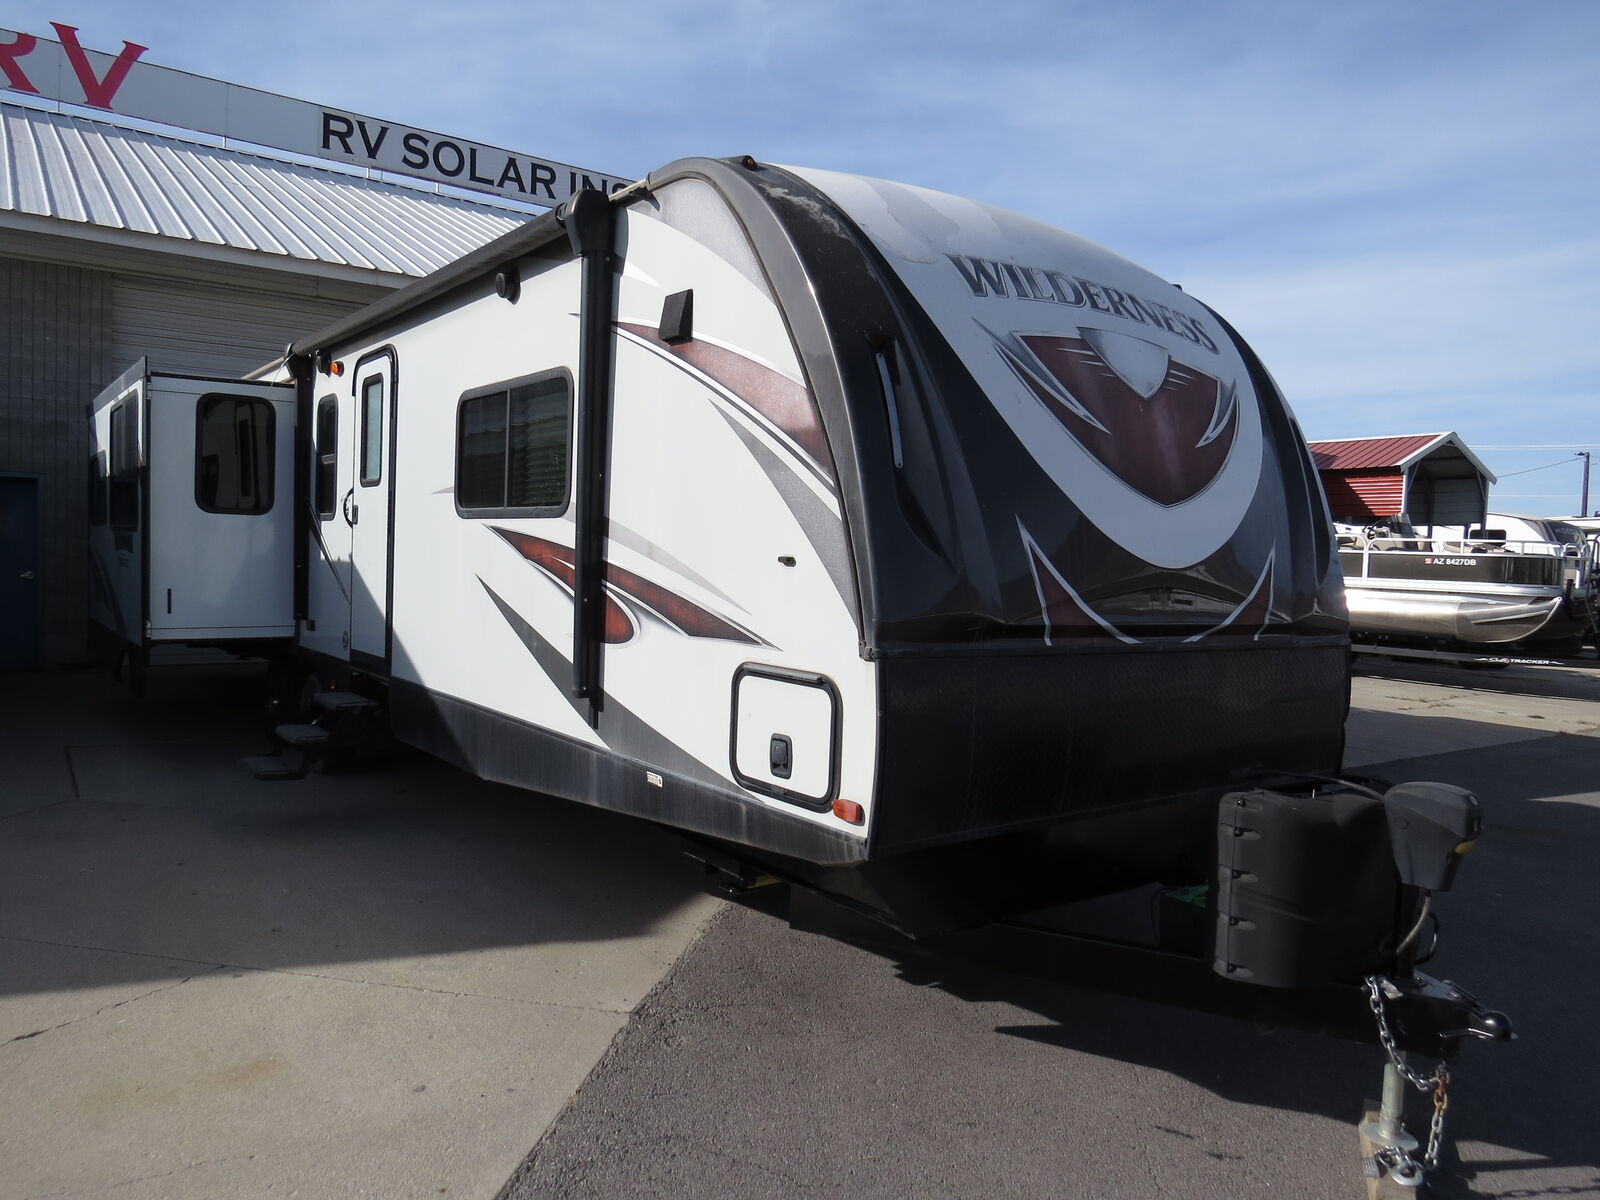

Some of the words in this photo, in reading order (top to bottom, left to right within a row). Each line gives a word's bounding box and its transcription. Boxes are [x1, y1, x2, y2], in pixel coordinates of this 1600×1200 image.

[321, 111, 390, 160] RV
[401, 132, 556, 199] SOLAR
[944, 252, 1220, 355] WILDERNESS
[1432, 557, 1445, 565] AZ
